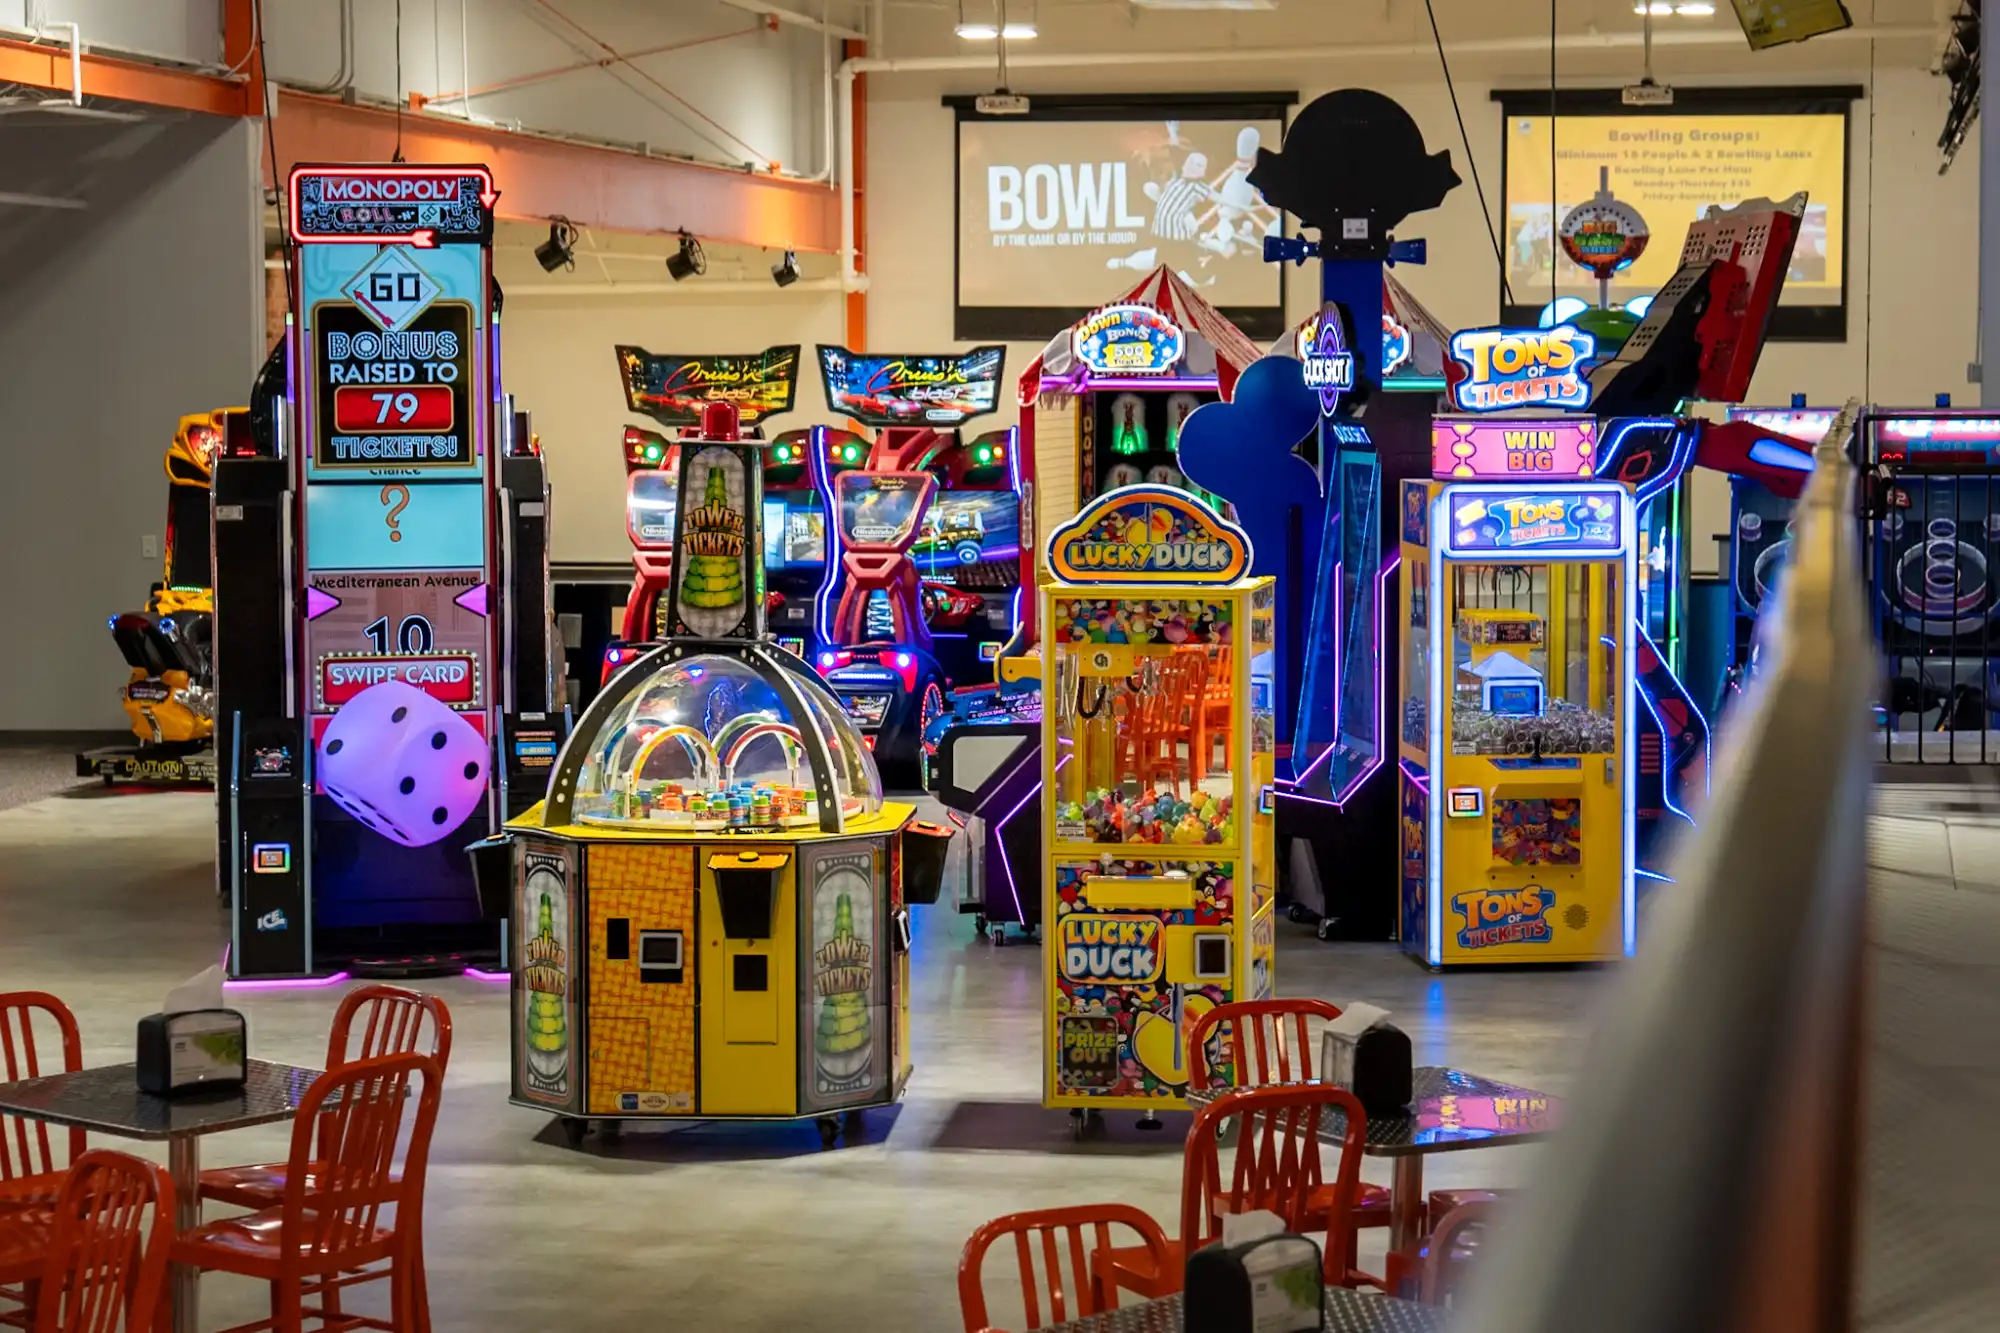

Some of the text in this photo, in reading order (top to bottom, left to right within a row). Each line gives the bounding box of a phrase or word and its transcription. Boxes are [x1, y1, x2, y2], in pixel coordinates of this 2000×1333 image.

[1608, 129, 1684, 145] Bowling
[1717, 148, 1772, 162] Bowling
[1776, 148, 1812, 159] Lanes
[326, 179, 456, 200] MONOPOLY
[987, 162, 1146, 232] BOWL
[341, 207, 395, 223] ROLL
[421, 205, 438, 222] GO
[370, 273, 420, 301] GO
[328, 331, 459, 360] BONUS
[1461, 328, 1576, 383] TONS
[330, 362, 458, 383] RAISED TO
[1527, 365, 1547, 378] OF
[1470, 373, 1578, 407] TICKETS
[371, 392, 419, 424] 79
[331, 436, 458, 459] TICKETS!
[1503, 431, 1556, 450] WIN
[1508, 452, 1553, 471] BIG
[685, 498, 745, 533] TOWER
[1504, 500, 1565, 528] TONS
[682, 531, 745, 557] TICKETS
[1509, 524, 1567, 541] TICKETS
[1069, 543, 1232, 570] LUCKY DUCK
[314, 575, 479, 589] Mediterranean Avenue
[364, 614, 434, 655] 10
[332, 665, 465, 686] SWIPE CARD
[125, 760, 184, 774] CAUTION!
[257, 909, 287, 931] ICE
[1457, 885, 1542, 929] TONS
[1508, 914, 1522, 924] OF
[1066, 919, 1158, 945] LUCKY
[1466, 918, 1546, 948] TICKETS
[526, 928, 566, 968] TOWER
[815, 928, 870, 968] TOWER
[1066, 947, 1156, 978] DUCK
[525, 966, 567, 997] TICKETS
[814, 966, 872, 997] TICKETS
[1064, 1031, 1118, 1048] PRIZE
[1070, 1048, 1111, 1064] OUT
